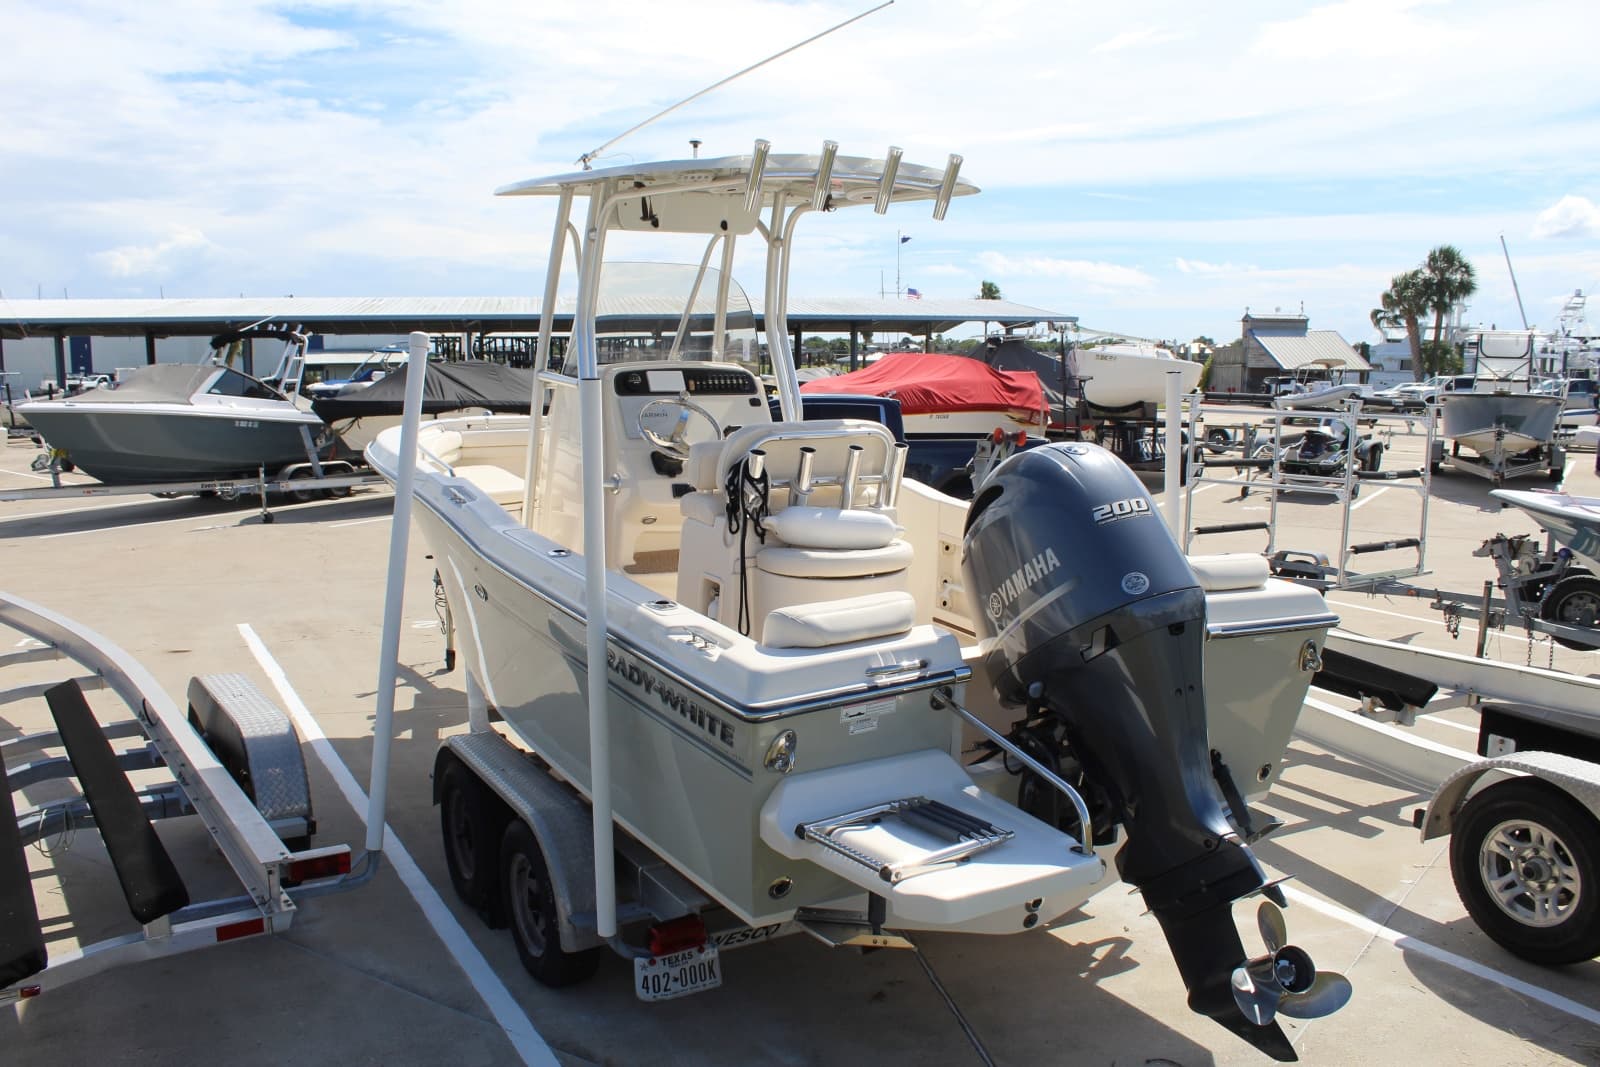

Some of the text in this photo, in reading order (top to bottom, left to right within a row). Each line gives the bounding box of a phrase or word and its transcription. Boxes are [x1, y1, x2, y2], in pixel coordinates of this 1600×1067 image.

[1092, 498, 1150, 523] 200
[996, 547, 1061, 606] YAMAHA
[607, 648, 735, 748] RADY-WHITE
[660, 951, 694, 967] TEXAS
